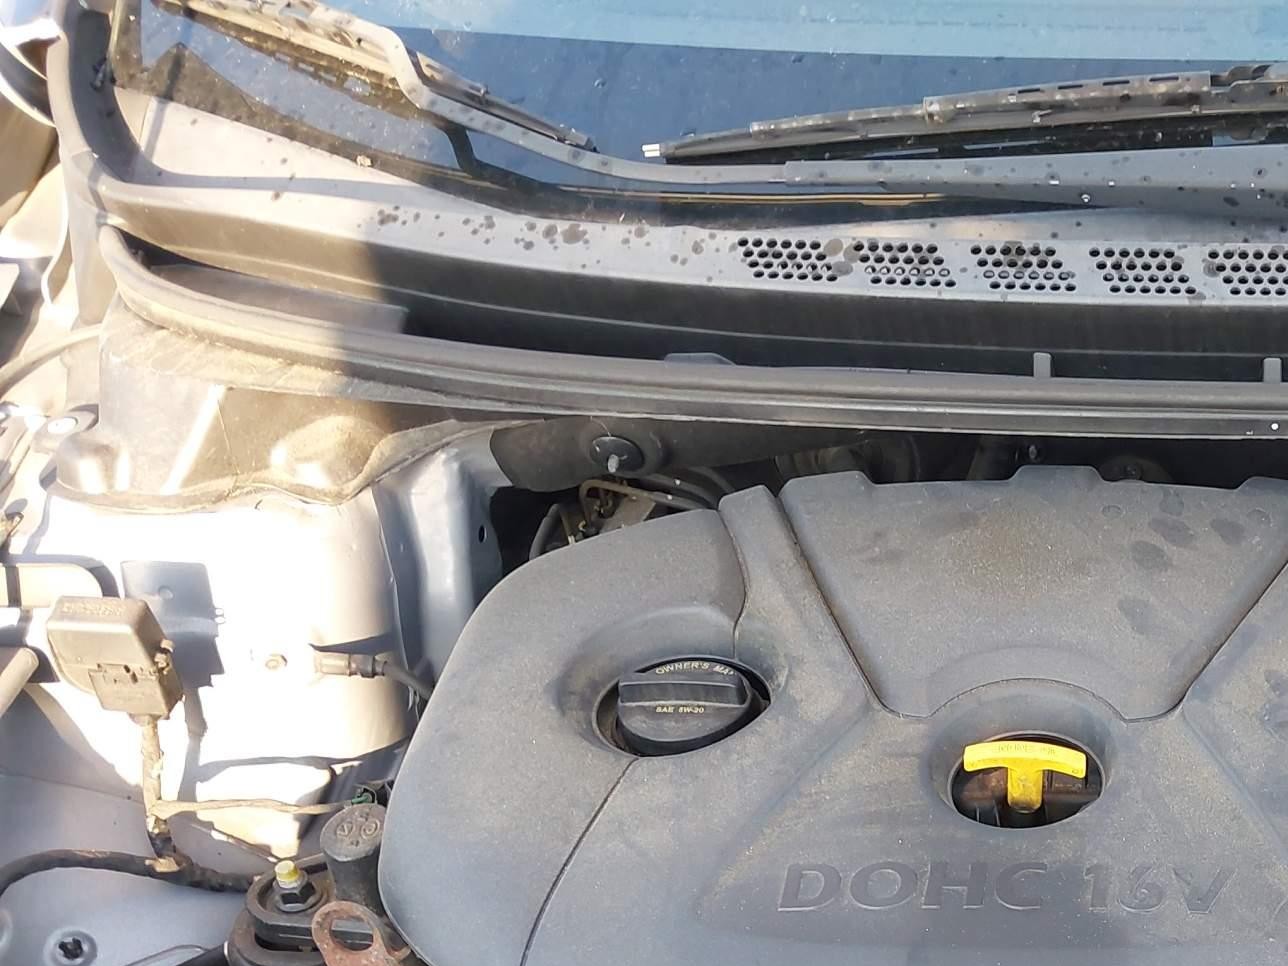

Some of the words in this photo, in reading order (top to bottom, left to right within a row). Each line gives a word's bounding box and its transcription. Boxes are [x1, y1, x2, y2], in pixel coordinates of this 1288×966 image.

[655, 660, 710, 675] OWNER'S
[778, 861, 1048, 912] DOHC
[1082, 865, 1237, 915] 16V
